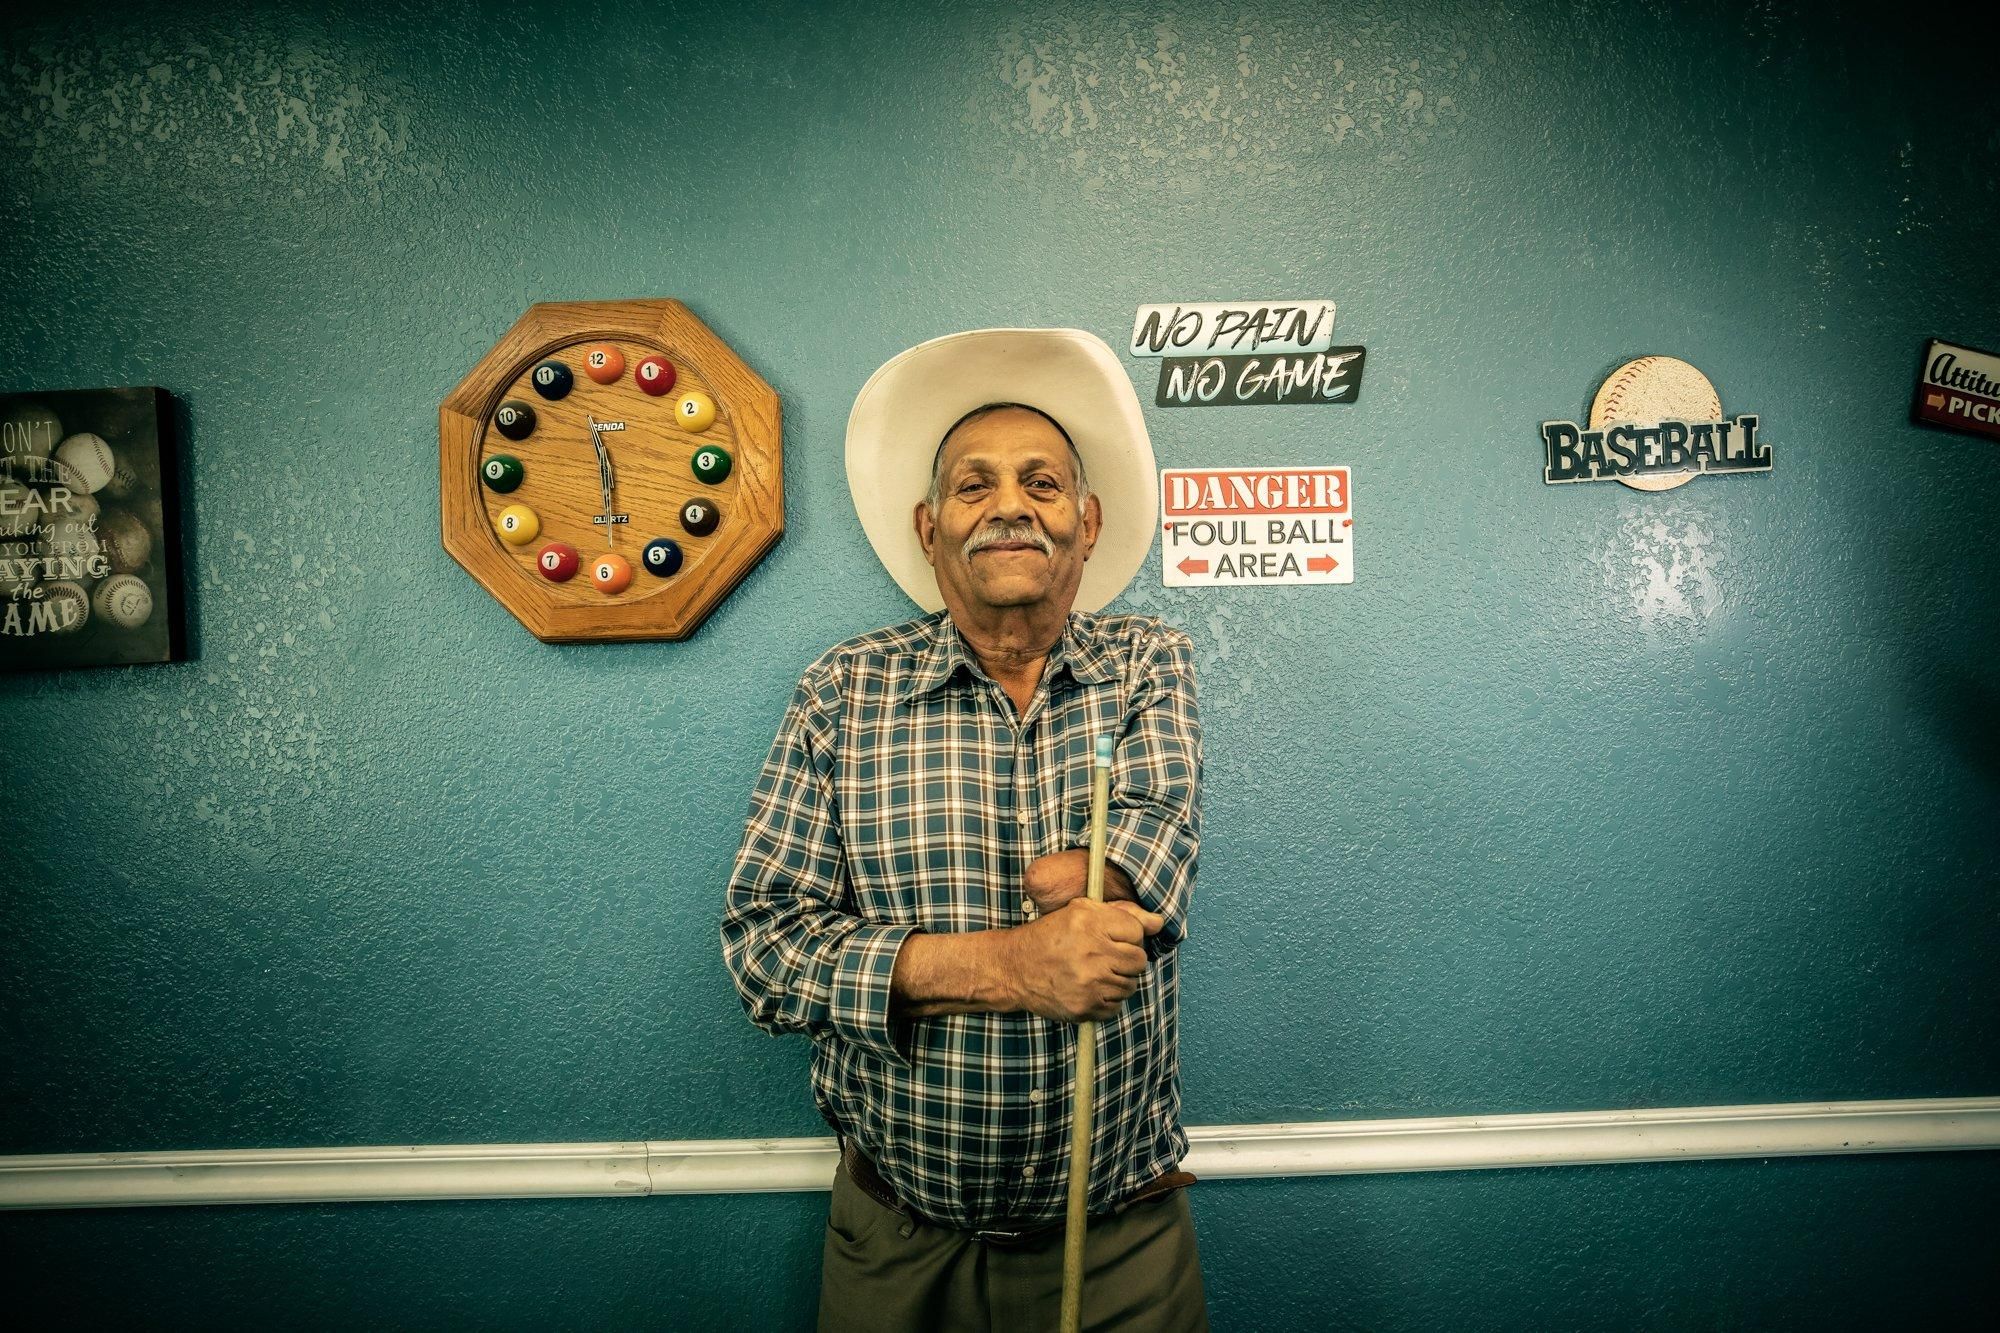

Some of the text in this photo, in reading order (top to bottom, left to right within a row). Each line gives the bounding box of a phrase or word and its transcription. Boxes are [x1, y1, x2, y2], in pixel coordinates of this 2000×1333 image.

[1135, 306, 1327, 352] NO PAIN
[590, 353, 604, 365] 12
[538, 370, 551, 382] 11
[646, 366, 653, 378] 1
[1166, 352, 1362, 402] NO GAME
[686, 402, 695, 415] 2
[1948, 396, 2000, 425] PICK
[500, 410, 514, 424] 10
[1545, 416, 1773, 482] BASEBALL
[703, 456, 710, 468] 3
[24, 455, 72, 485] THE
[490, 464, 498, 476] 9
[1171, 474, 1343, 511] DANGER
[594, 515, 628, 524] QURTZ
[690, 509, 698, 521] 4
[65, 513, 99, 533] out
[506, 517, 514, 529] 8
[1172, 519, 1343, 546] FOUL BALL
[2, 539, 108, 556] YOU FROM
[546, 555, 554, 567] 7
[653, 549, 661, 561] 5
[1214, 552, 1302, 578] AREA
[600, 566, 608, 578] 6
[10, 582, 44, 601] the
